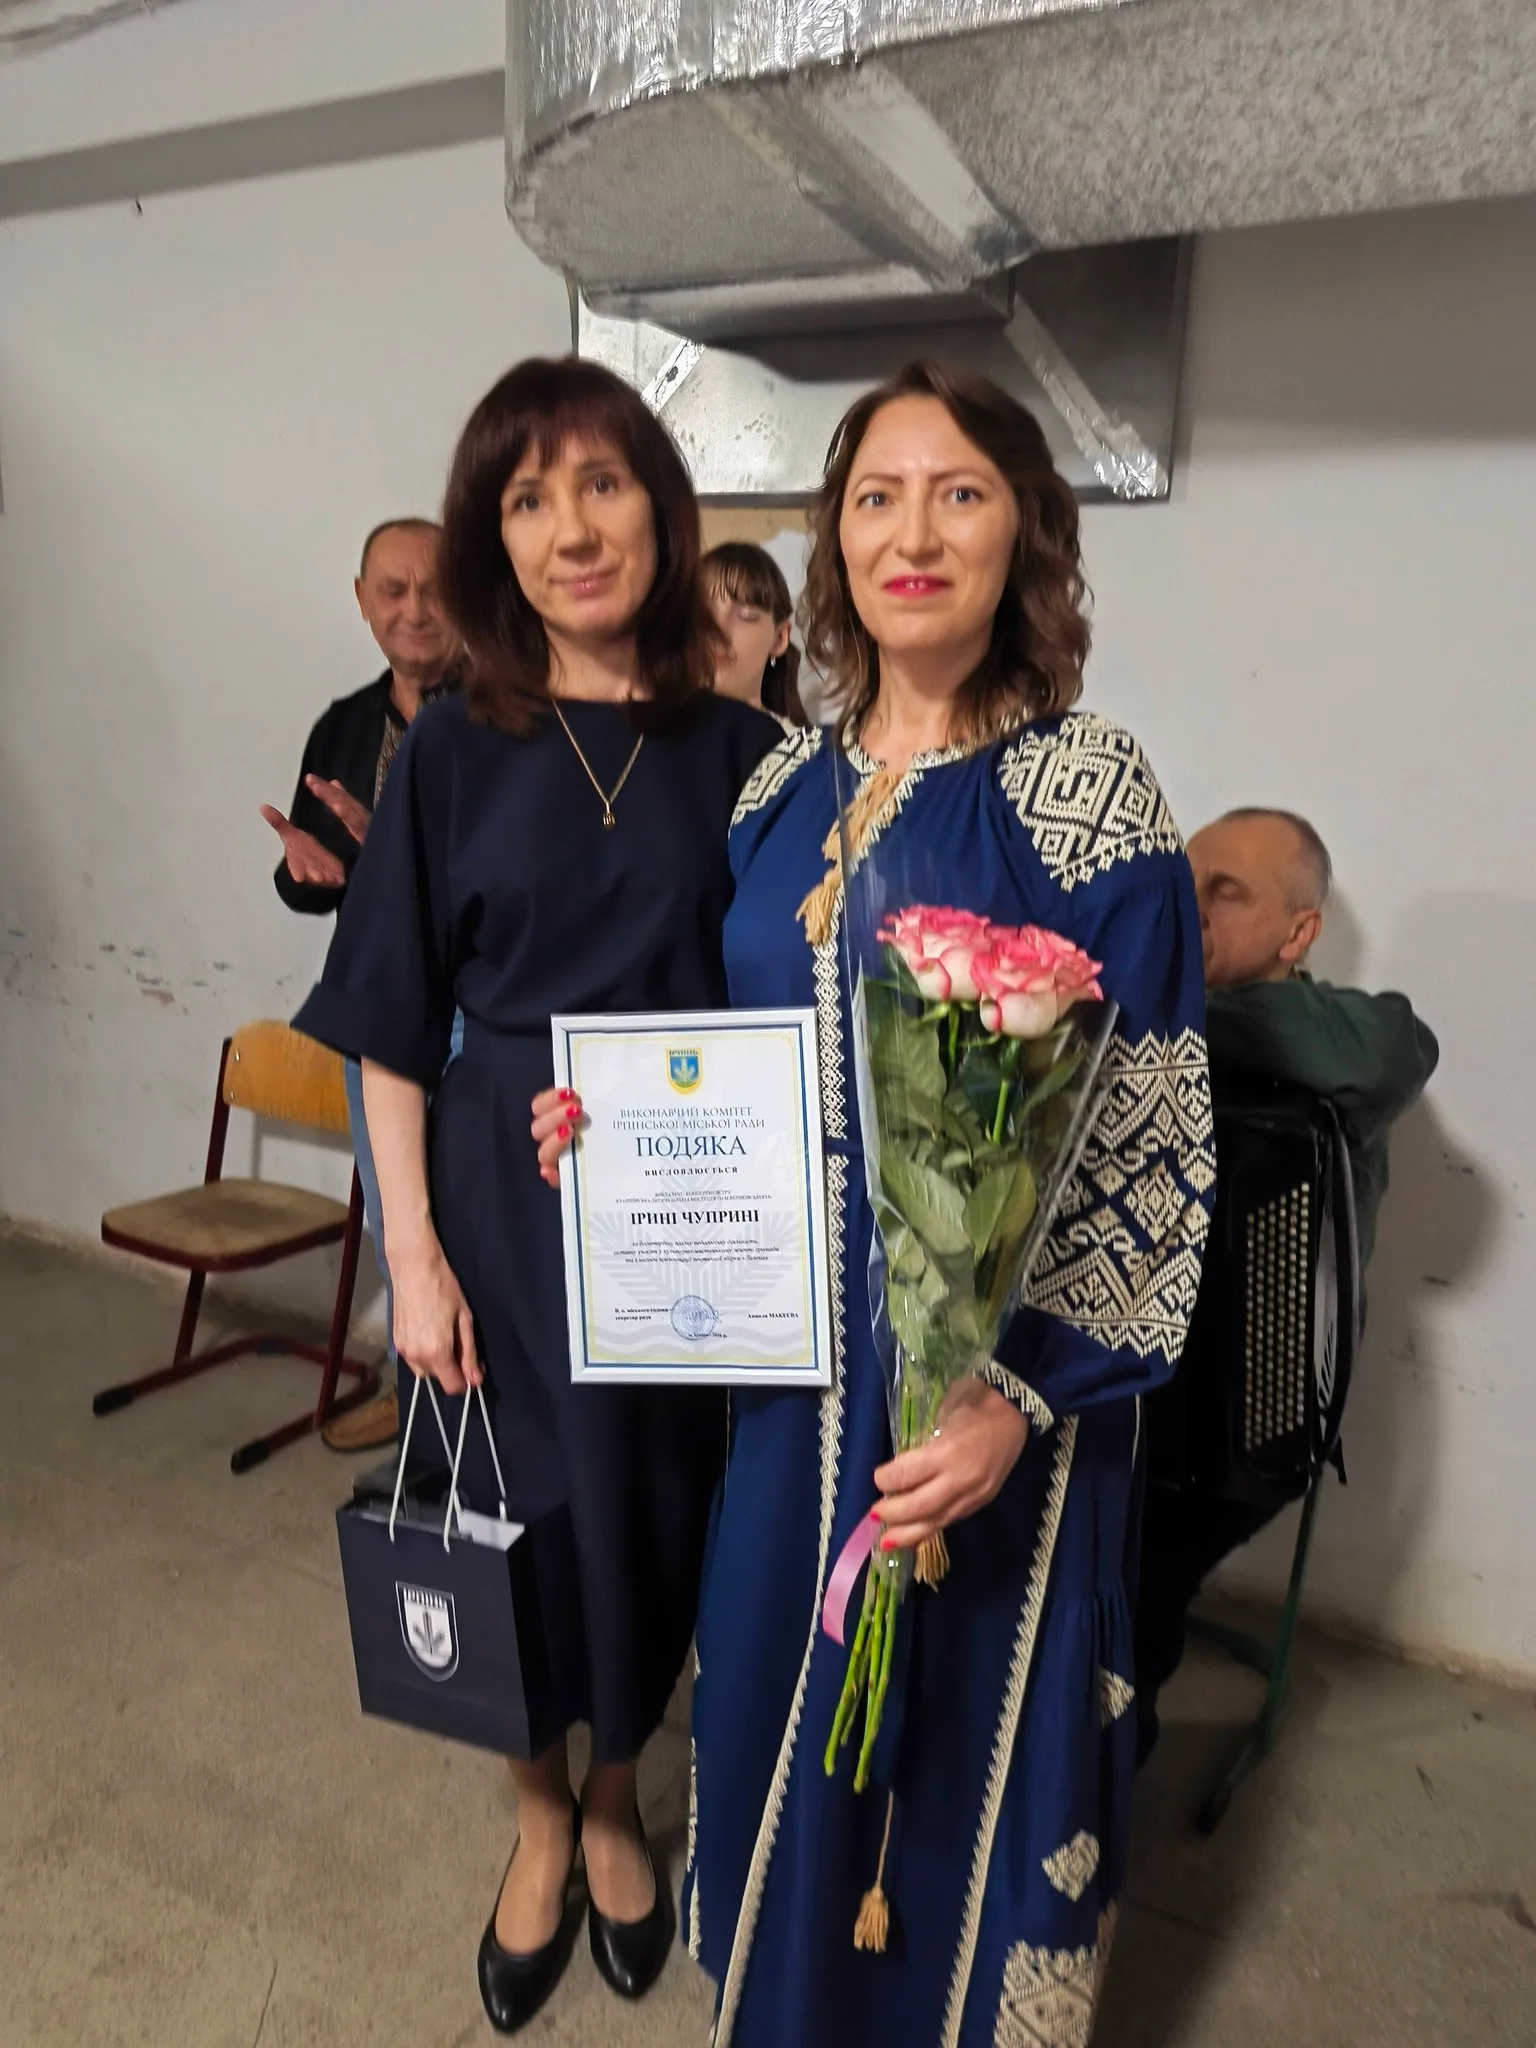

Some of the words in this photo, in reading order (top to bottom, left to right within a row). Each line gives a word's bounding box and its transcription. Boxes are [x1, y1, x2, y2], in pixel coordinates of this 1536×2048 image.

[620, 1106, 699, 1118] ВИКОНАВЧИЙ
[702, 1107, 753, 1117] КОМІТЕТ
[612, 1119, 679, 1130] ІРПІНСЬКОЇ
[682, 1119, 731, 1129] МІСЬКОЇ
[735, 1118, 765, 1128] РАДИ
[635, 1135, 748, 1160] ПОДЯКА
[630, 1212, 677, 1224] ІРИНІ
[681, 1210, 760, 1224] ЧУПРИНІ
